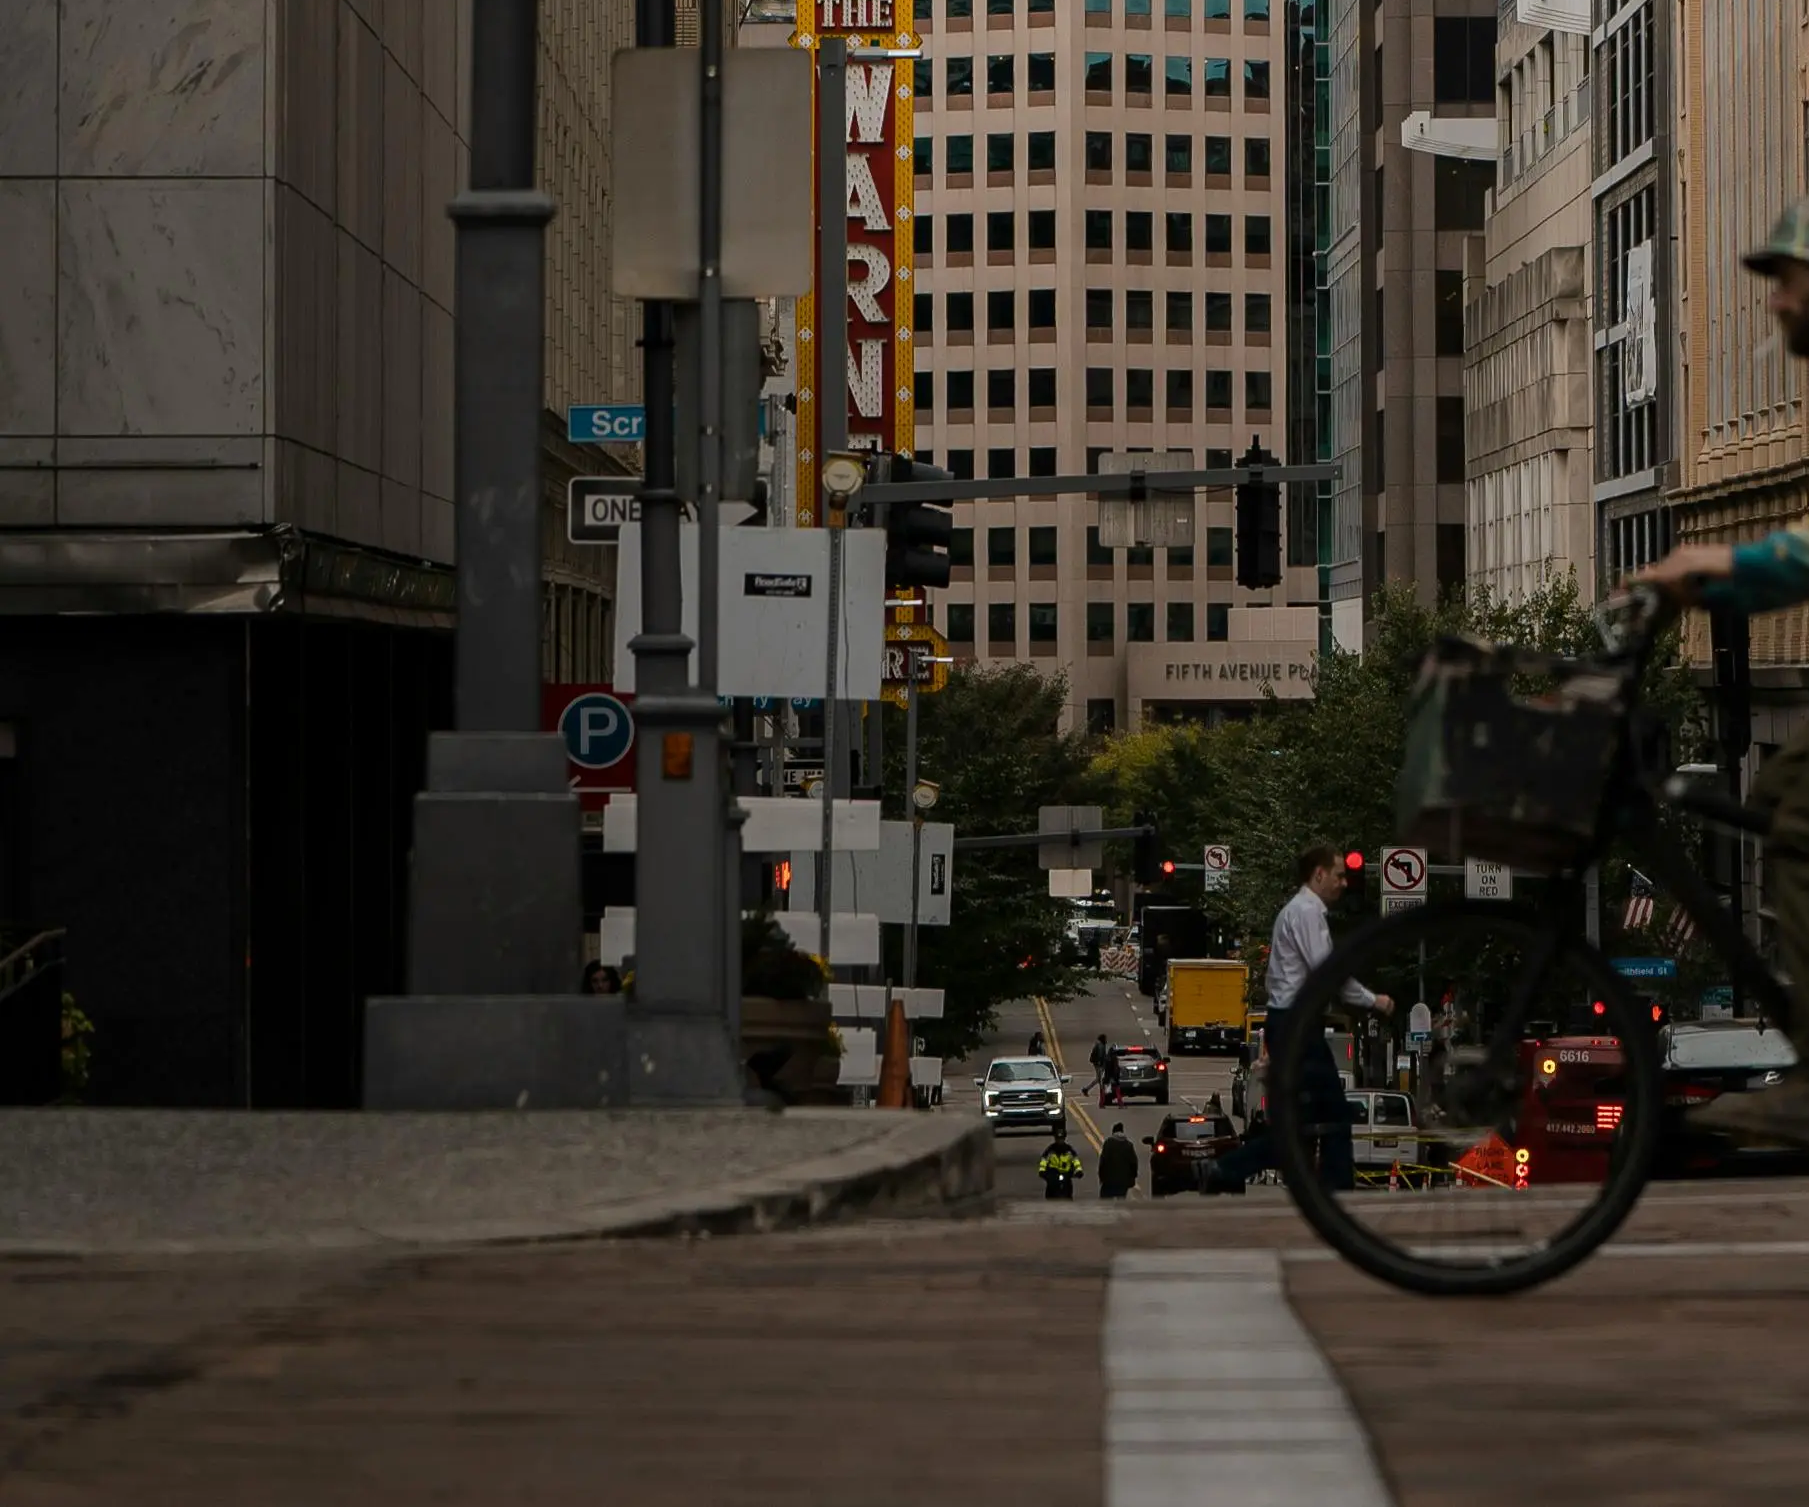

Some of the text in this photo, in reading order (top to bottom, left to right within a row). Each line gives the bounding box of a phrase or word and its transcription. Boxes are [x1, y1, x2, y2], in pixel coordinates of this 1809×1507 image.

[591, 410, 643, 436] Scr
[592, 498, 642, 522] ONE
[1165, 663, 1213, 682] FIFTH
[1218, 663, 1282, 682] AVENUE
[1475, 864, 1502, 874] TURN
[1481, 875, 1497, 885] ON
[1478, 886, 1499, 897] RED
[1559, 1049, 1590, 1063] 6616
